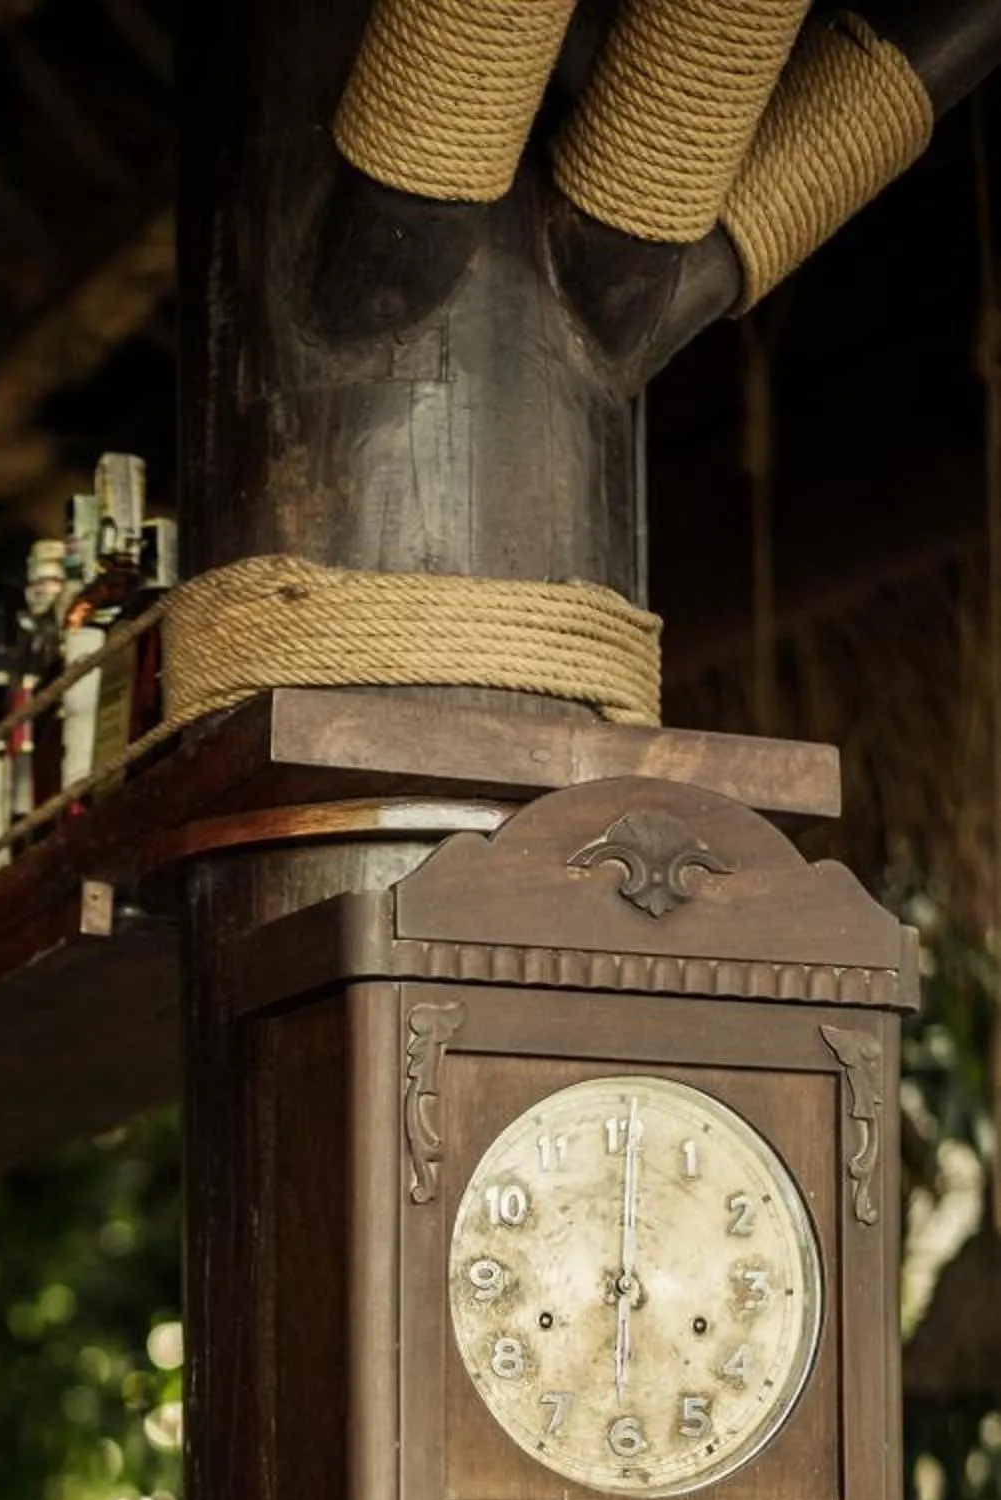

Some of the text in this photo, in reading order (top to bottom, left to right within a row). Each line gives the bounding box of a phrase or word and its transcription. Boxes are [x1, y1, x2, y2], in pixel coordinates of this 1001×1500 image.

[538, 1135, 567, 1170] 11
[681, 1141, 697, 1177] 1
[486, 1185, 527, 1225] 10
[729, 1195, 754, 1235] 2
[470, 1259, 503, 1299] 9
[744, 1271, 768, 1308] 3
[491, 1338, 524, 1379] 8
[722, 1344, 752, 1383] 4
[540, 1392, 570, 1434] 7
[679, 1397, 712, 1437] 5
[608, 1418, 644, 1457] 6
